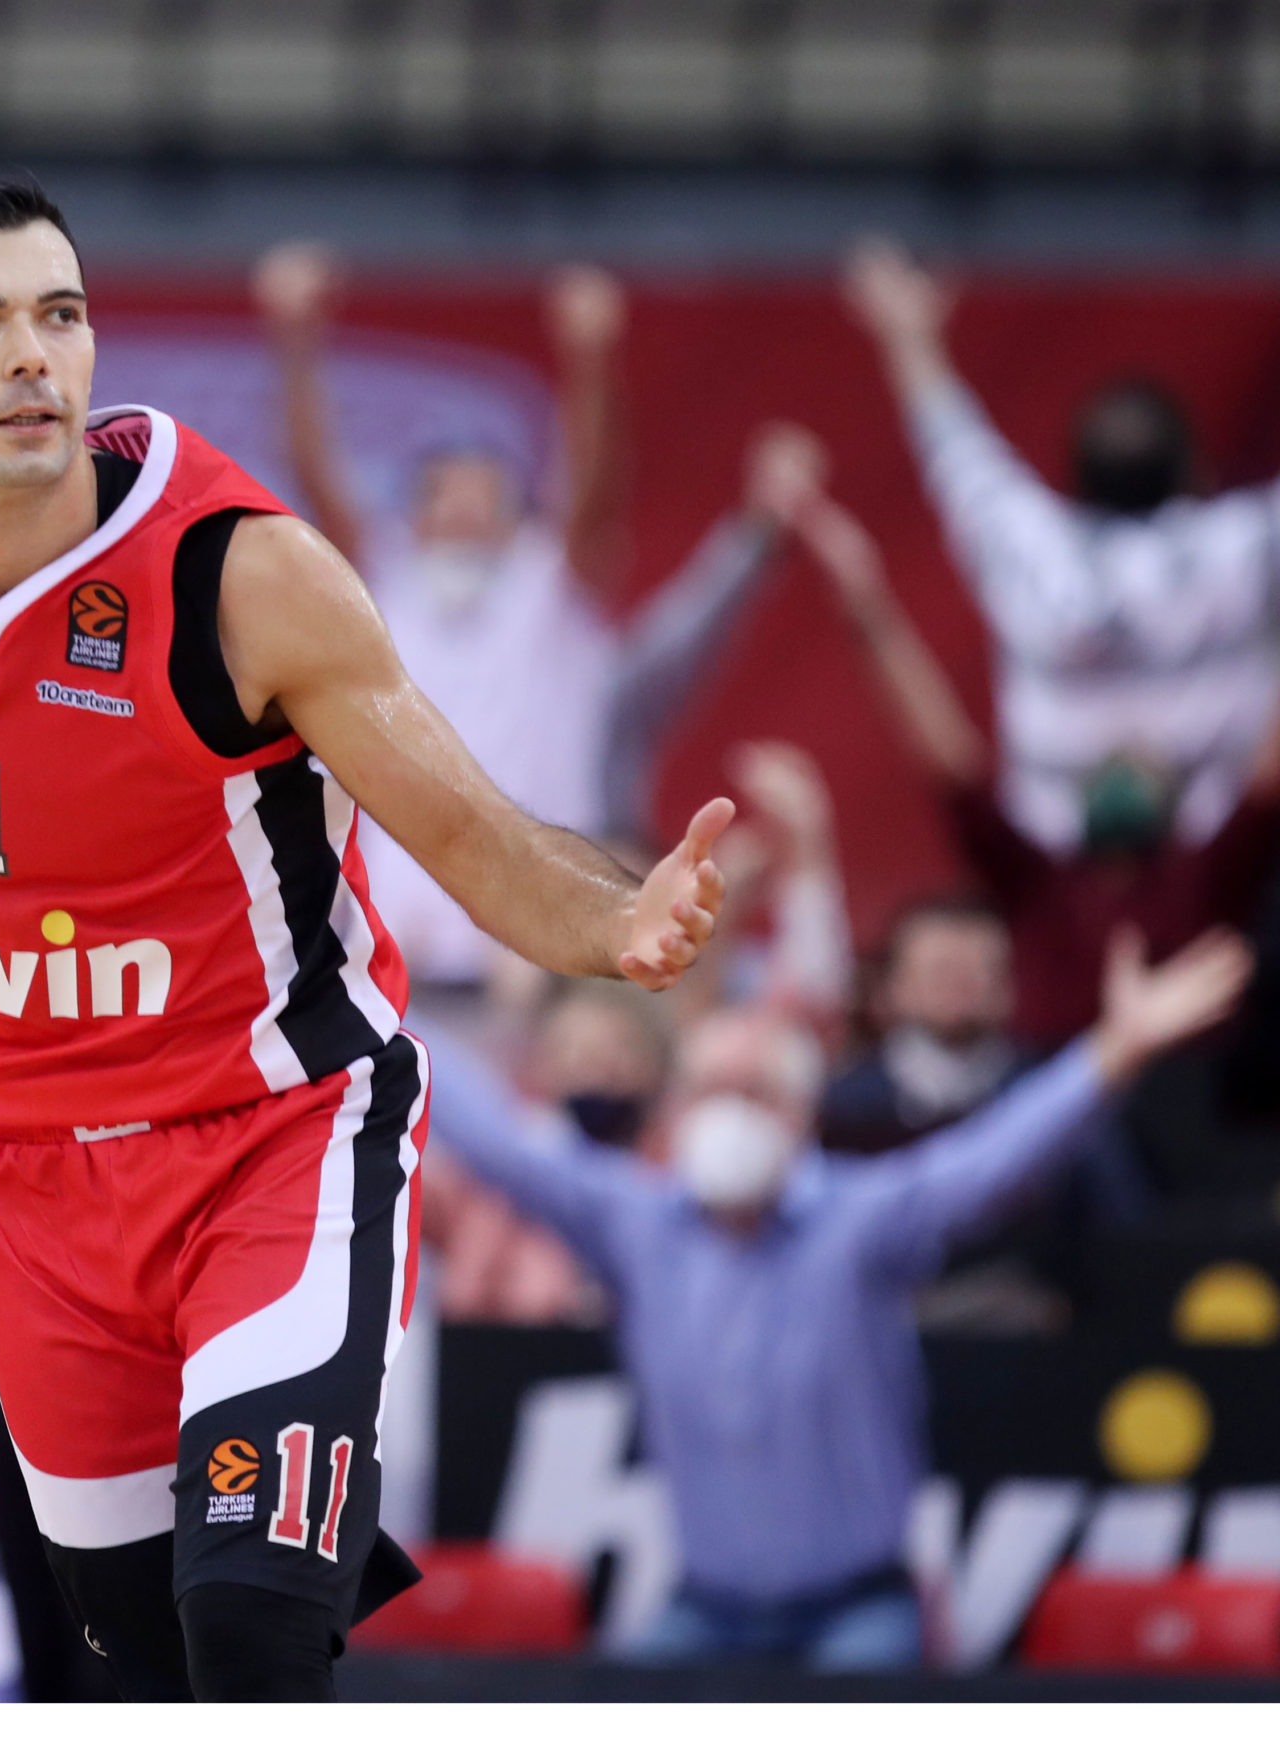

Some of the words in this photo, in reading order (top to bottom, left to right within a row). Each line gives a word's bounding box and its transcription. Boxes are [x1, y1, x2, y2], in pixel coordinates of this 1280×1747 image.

[72, 633, 121, 653] TURKISH
[70, 643, 120, 662] AIRLINES
[208, 1493, 256, 1506] TURKISH
[267, 1421, 354, 1564] 11
[207, 1503, 255, 1516] AIRLINES
[205, 1513, 254, 1524] EuroLeague
